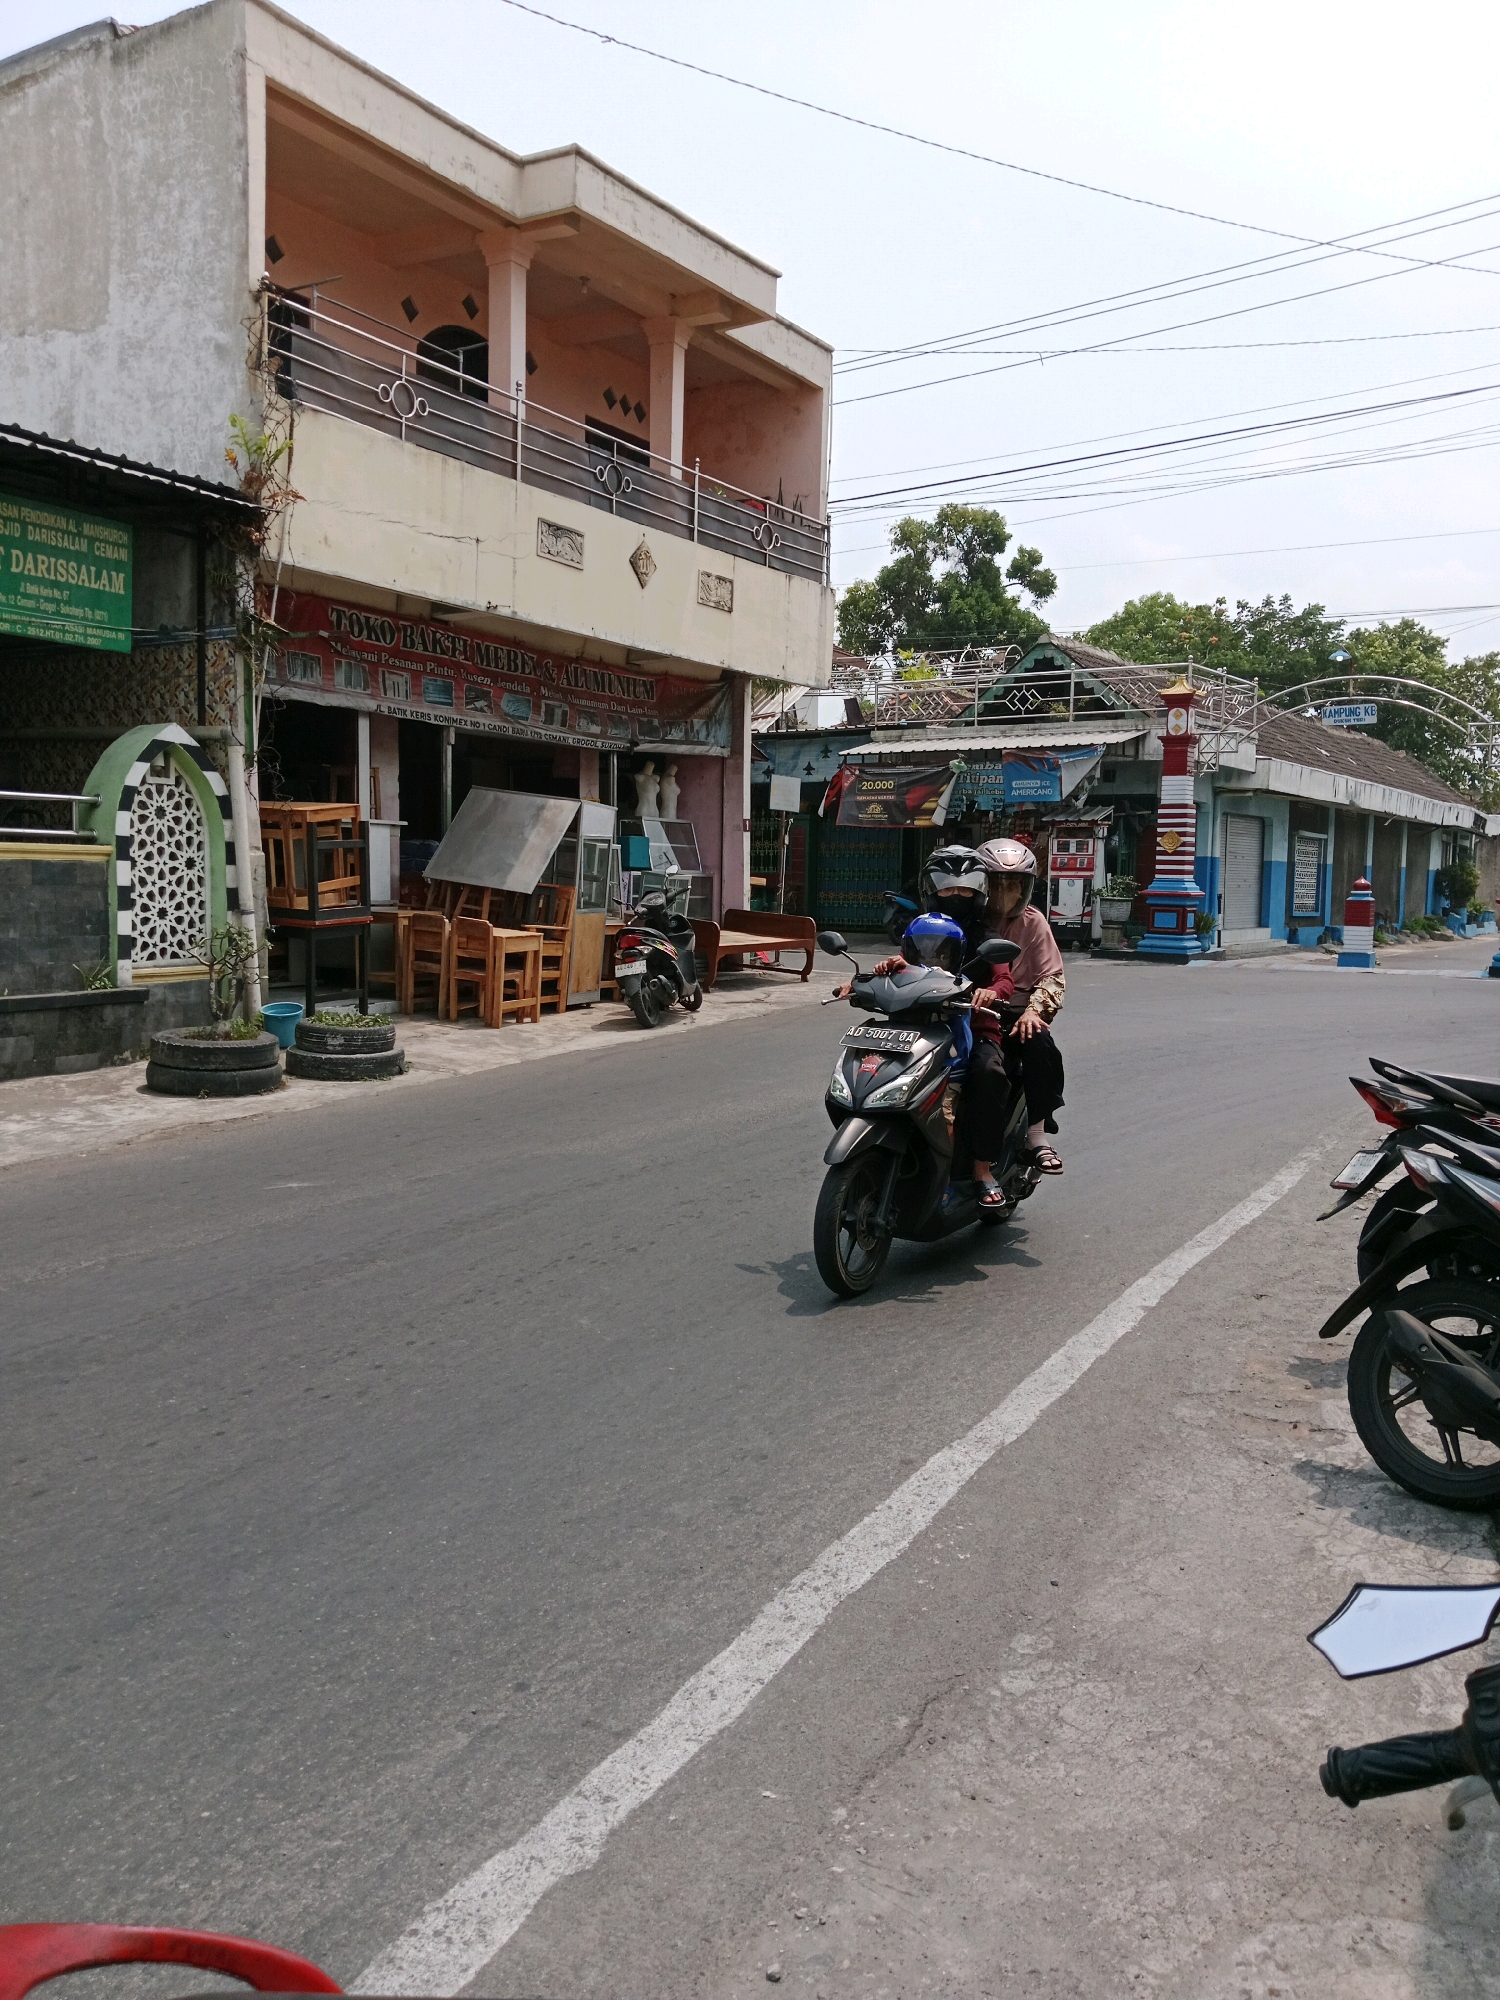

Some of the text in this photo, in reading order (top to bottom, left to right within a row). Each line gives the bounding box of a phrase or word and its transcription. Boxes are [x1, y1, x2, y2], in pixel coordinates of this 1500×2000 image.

[20, 507, 66, 530] PENDIDIKAN
[68, 519, 77, 533] AL
[83, 522, 128, 544] MANSHUROH
[28, 525, 88, 552] DARISSALAM
[94, 542, 128, 562] CEMANI
[10, 549, 125, 595] DARISSALAM
[16, 624, 22, 633] C
[87, 636, 102, 646] 2007
[64, 624, 84, 634] ASASI
[86, 627, 116, 640] MANUSIA
[117, 632, 125, 640] RI
[328, 606, 397, 647] TOKO
[399, 622, 472, 664] BAKTI
[542, 660, 557, 685] &
[560, 662, 656, 702] ALUMUNIUM
[330, 641, 378, 662] Melayani
[381, 652, 424, 671] Pesanan
[426, 661, 457, 678] Pintu,
[461, 668, 494, 687] Kusen,
[497, 674, 530, 694] Jendela
[610, 701, 625, 712] Dan
[387, 706, 408, 718] BATIK
[410, 710, 431, 721] KERIS
[434, 714, 467, 726] KONIMEX
[470, 720, 480, 728] NO
[487, 723, 510, 734] CANDI
[1322, 707, 1361, 719] KAMPUNG
[862, 781, 894, 790] 20.000
[958, 772, 1004, 786] Titipan
[746, 820, 749, 830] 1
[846, 1026, 863, 1036] AD
